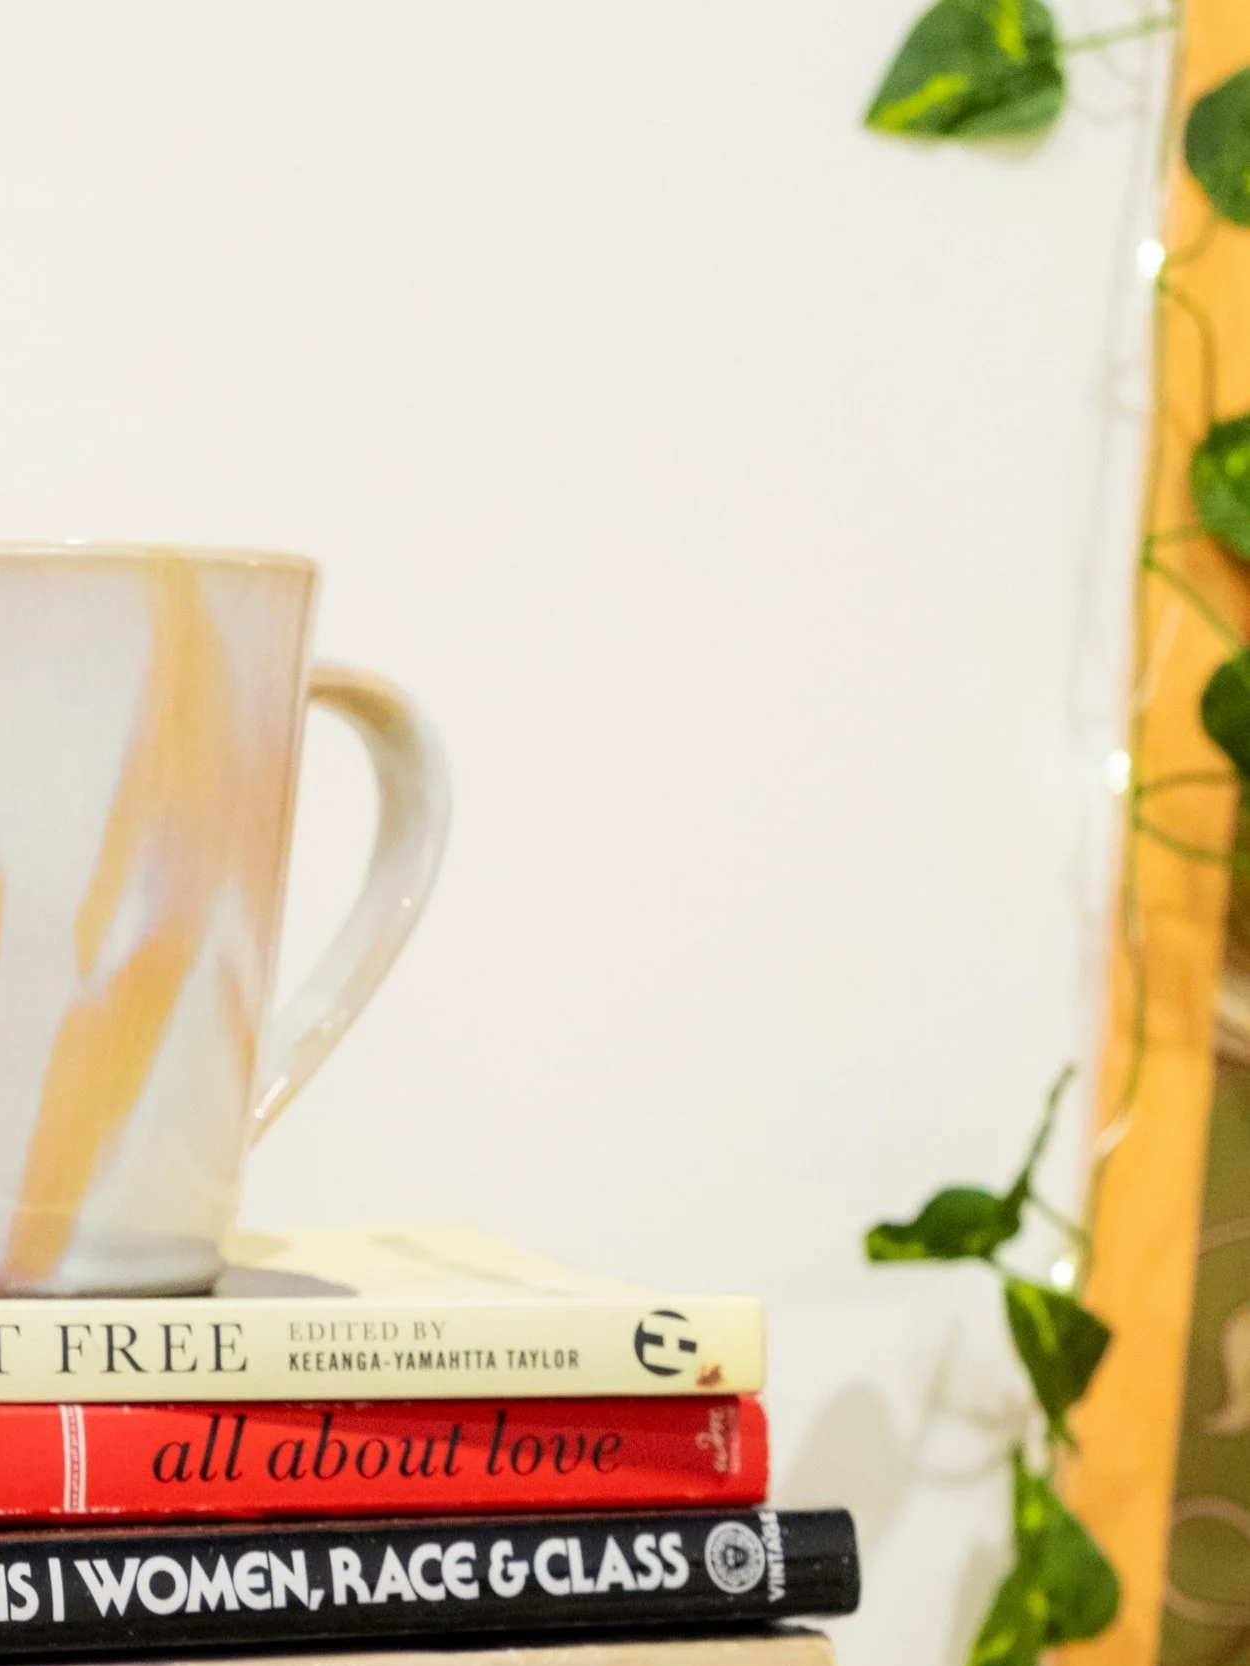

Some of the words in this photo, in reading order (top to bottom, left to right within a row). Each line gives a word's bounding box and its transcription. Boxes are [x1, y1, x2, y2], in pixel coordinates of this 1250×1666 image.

[56, 1322, 249, 1374] FREE
[288, 1348, 498, 1374] KEEANGA-YAMAHTTA
[506, 1348, 581, 1371] TAYLOR
[289, 1320, 401, 1343] EDITED
[412, 1320, 448, 1342] BY
[152, 1413, 247, 1485] all
[269, 1411, 464, 1480] about
[487, 1409, 624, 1476] love
[74, 1549, 325, 1615] WOMEN,
[334, 1542, 476, 1606] RACE
[487, 1540, 529, 1595] &
[532, 1532, 689, 1594] CLASS
[758, 1511, 788, 1604] VINTAGE
